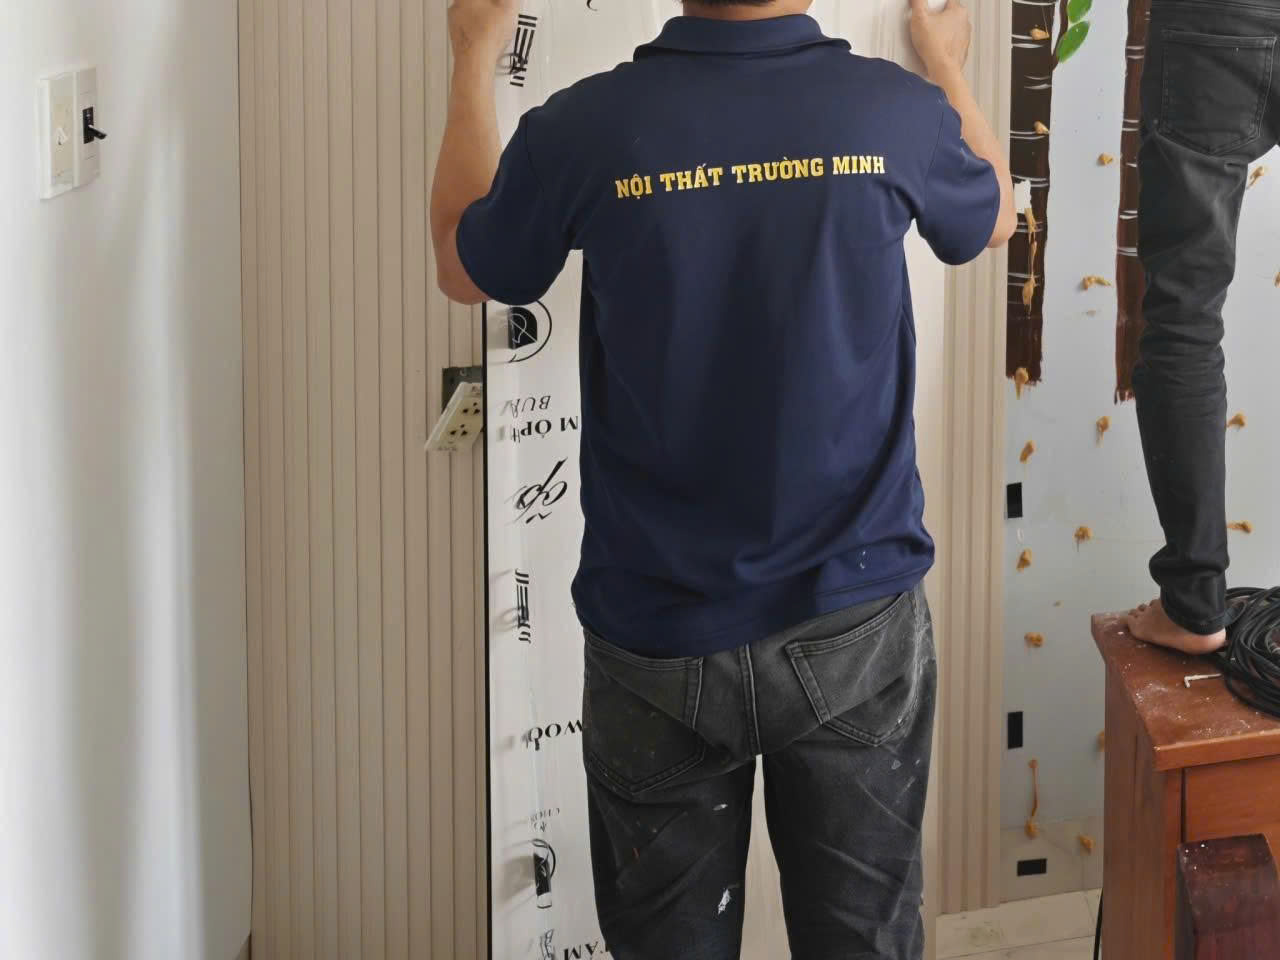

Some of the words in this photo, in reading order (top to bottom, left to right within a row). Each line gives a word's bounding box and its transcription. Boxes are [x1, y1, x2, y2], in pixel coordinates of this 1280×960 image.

[615, 173, 653, 200] NỘI
[659, 162, 724, 192] THẤT
[731, 156, 825, 184] TRƯỜNG
[832, 155, 886, 176] MINH
